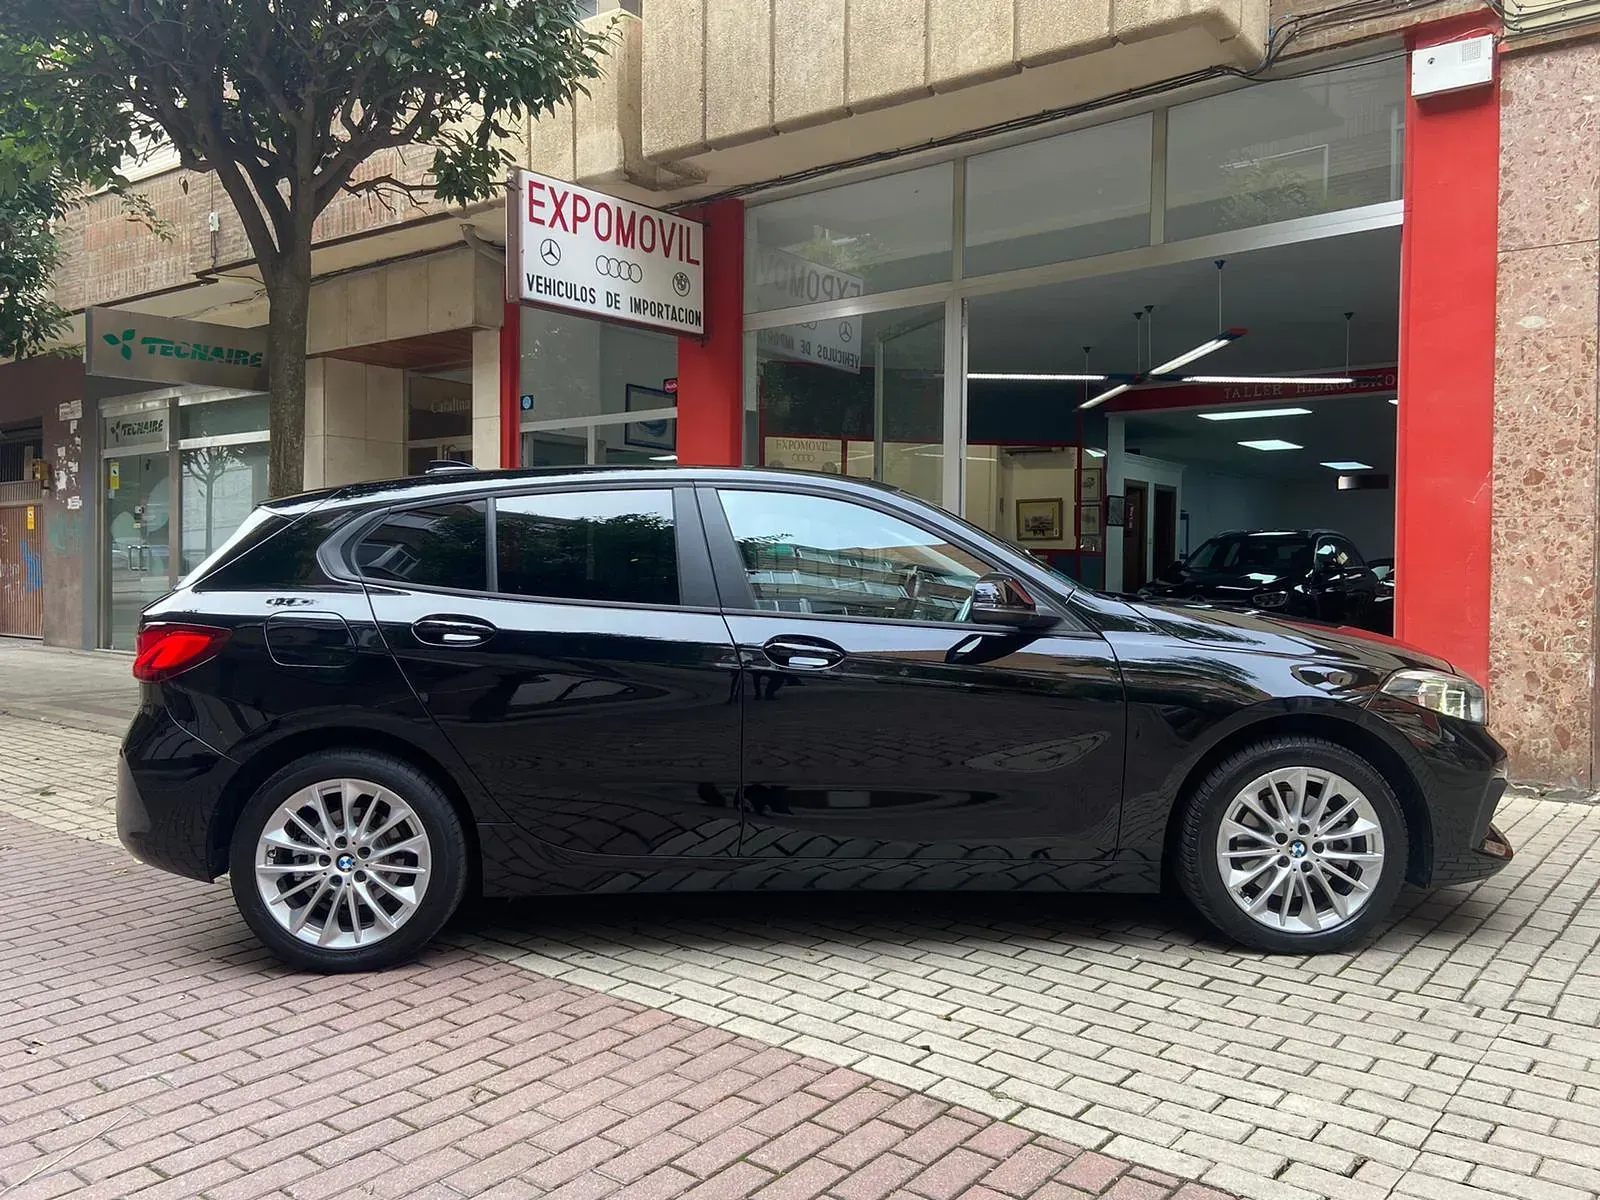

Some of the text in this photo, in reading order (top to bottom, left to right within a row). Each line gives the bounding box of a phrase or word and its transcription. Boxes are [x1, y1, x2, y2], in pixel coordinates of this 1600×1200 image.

[527, 180, 700, 267] EXPOMOVIL
[526, 273, 702, 328] VEHICULOS DE IMPORTACION
[141, 336, 263, 368] TECNAIRE
[1224, 386, 1283, 399] TALLER
[121, 419, 163, 437] TECNAIRE
[775, 439, 832, 452] EXPOMOVIL
